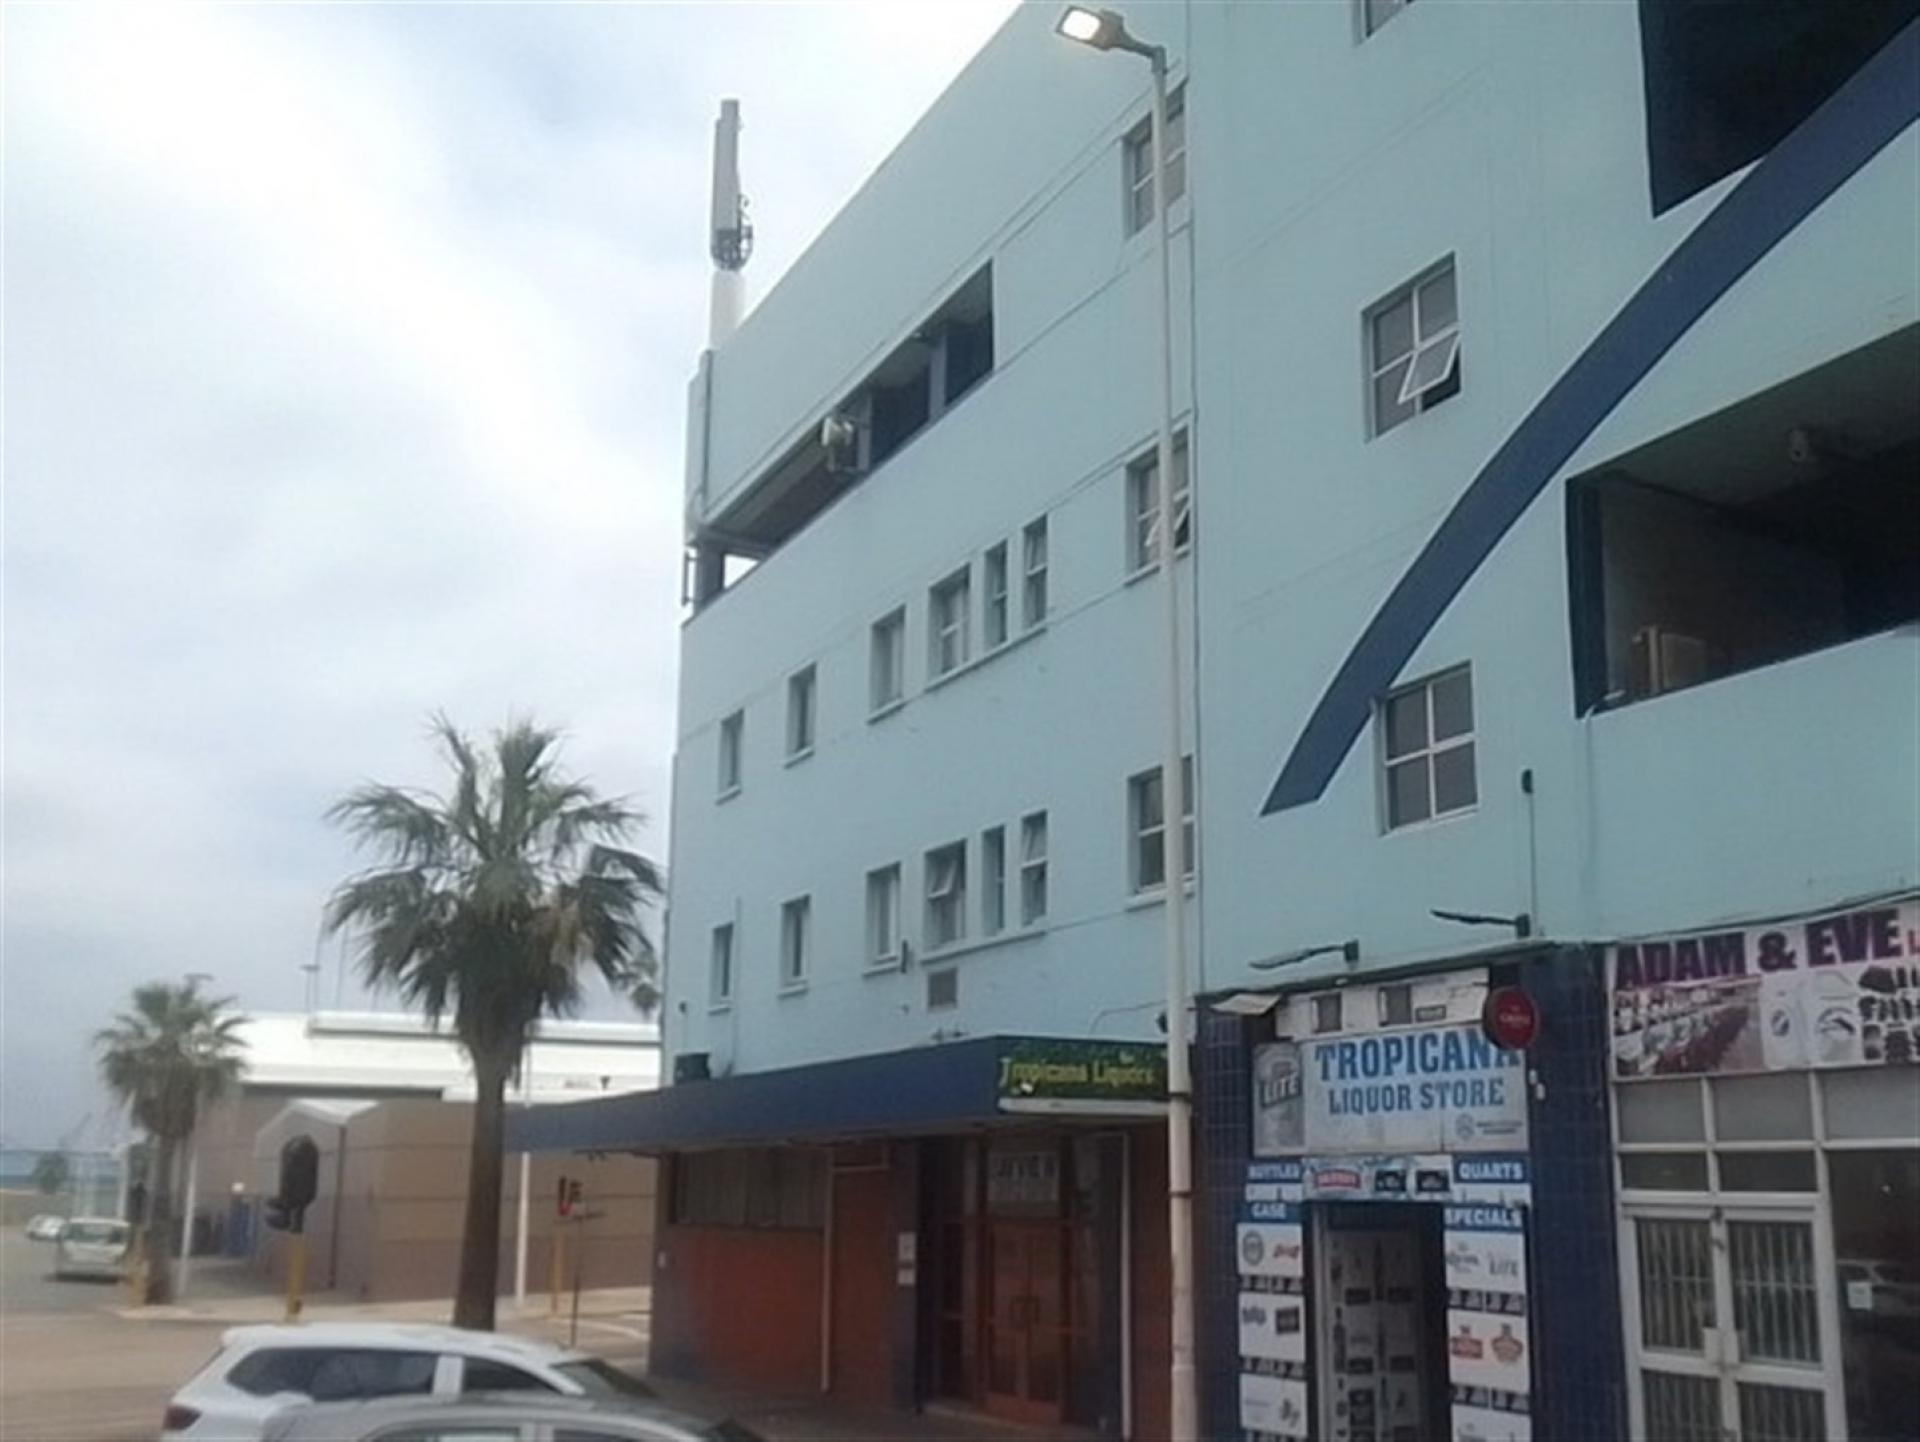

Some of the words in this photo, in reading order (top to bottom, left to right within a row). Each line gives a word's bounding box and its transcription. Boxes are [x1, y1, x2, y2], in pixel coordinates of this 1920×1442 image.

[1614, 931, 1746, 987] ADAM
[1757, 931, 1798, 971] &
[1805, 908, 1903, 967] EVE
[1261, 1072, 1299, 1104] LITE
[1328, 1086, 1412, 1116] LIQUOR
[1420, 1078, 1505, 1109] STORE
[1458, 1162, 1523, 1180] QUARTS
[1252, 1202, 1287, 1219] CASE
[1444, 1206, 1522, 1228] SPECIALS
